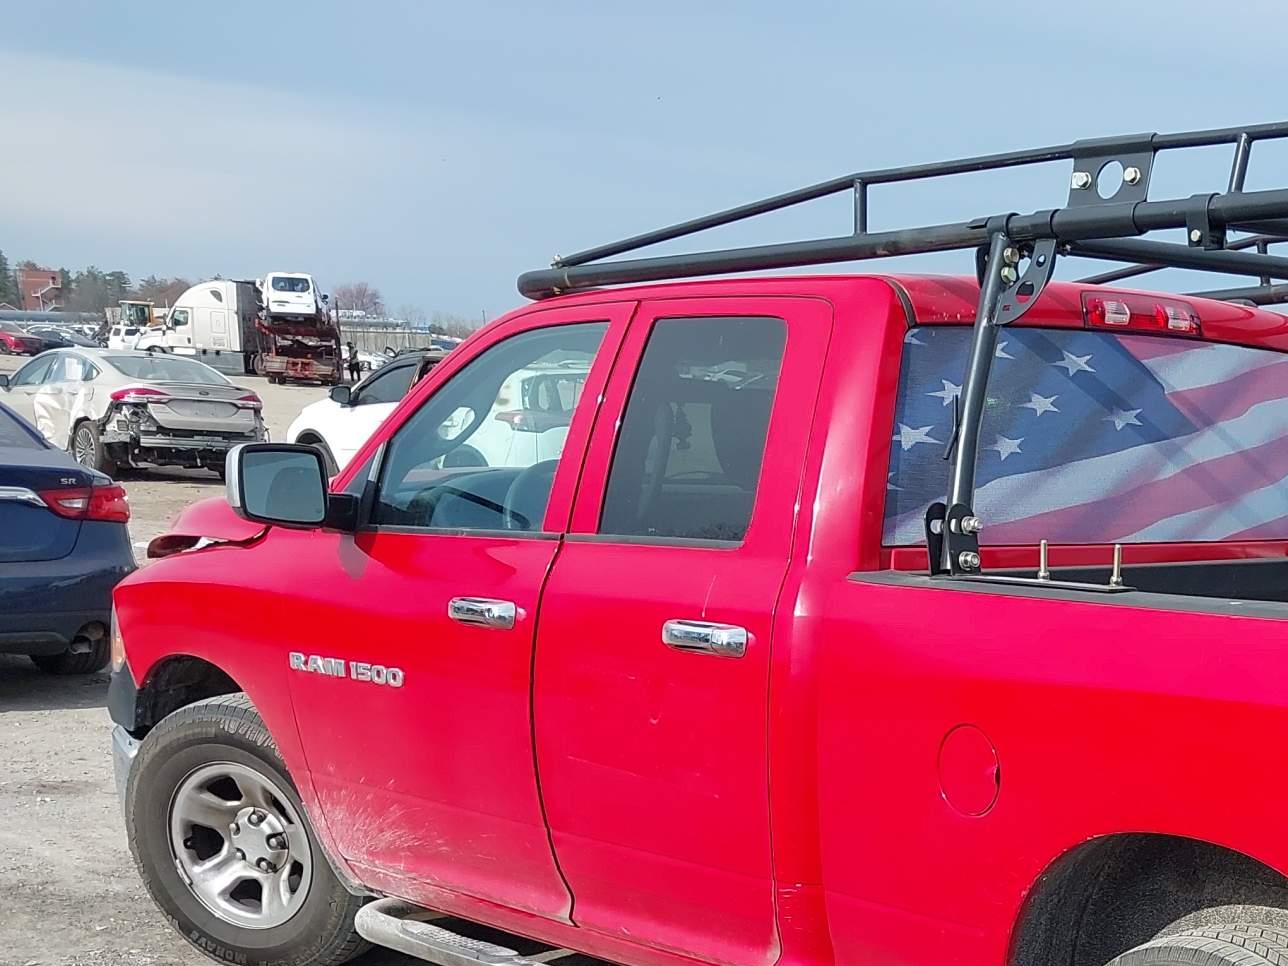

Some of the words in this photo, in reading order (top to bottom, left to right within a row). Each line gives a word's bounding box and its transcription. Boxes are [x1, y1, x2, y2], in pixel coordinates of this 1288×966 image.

[60, 477, 77, 485] SR
[288, 651, 347, 678] RAM
[349, 661, 405, 688] 1500
